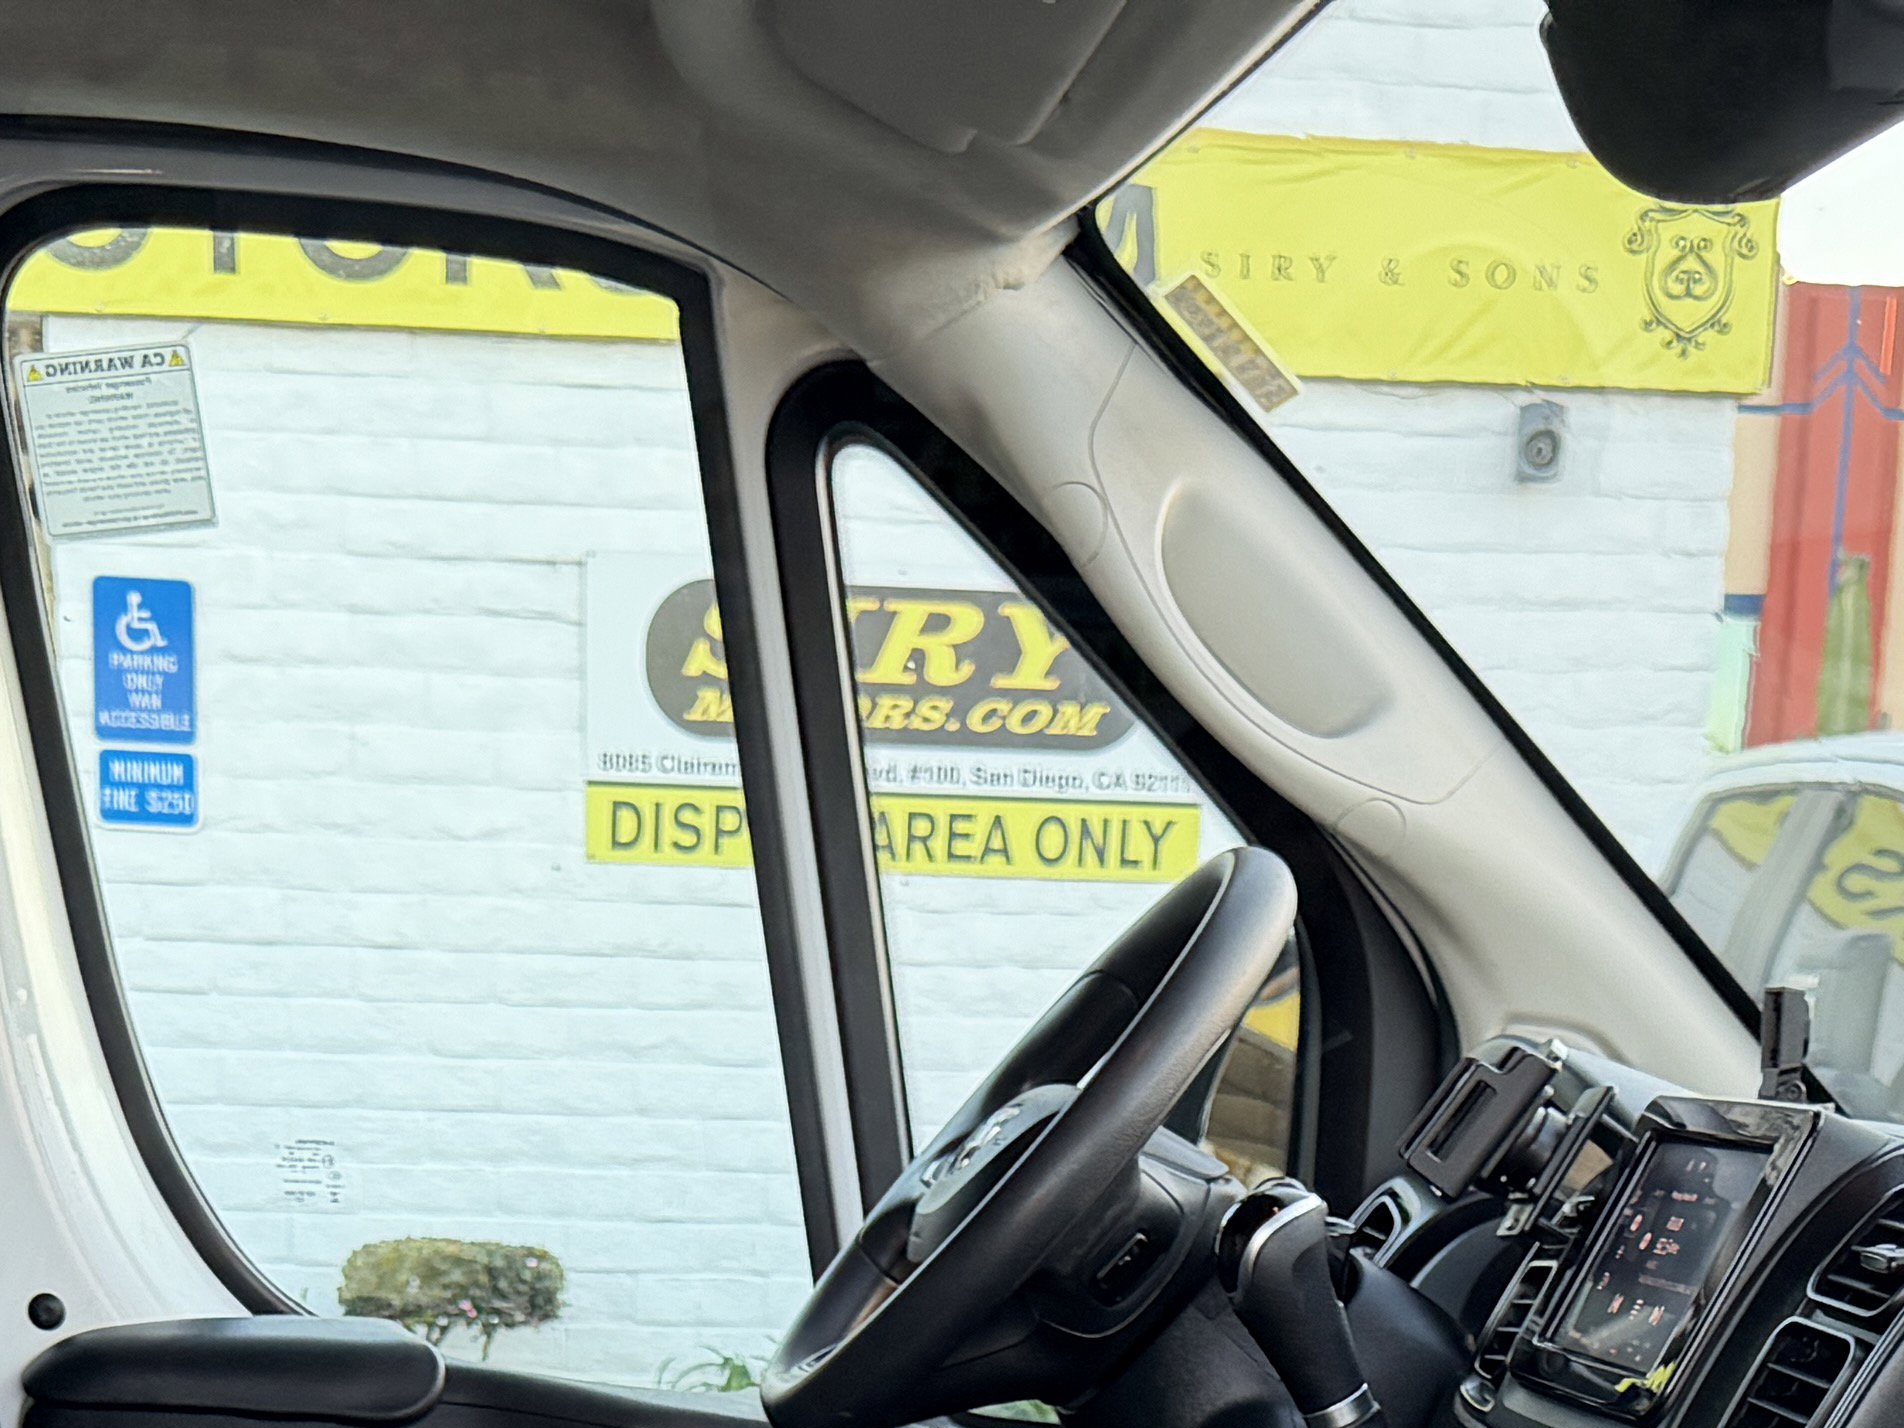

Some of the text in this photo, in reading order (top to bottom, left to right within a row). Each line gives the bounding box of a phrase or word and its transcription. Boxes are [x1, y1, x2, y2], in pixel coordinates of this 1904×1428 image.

[1200, 249, 1600, 294] SIRY & SONS
[109, 652, 179, 674] PARKING
[110, 759, 185, 786] MINIMUM
[611, 799, 1177, 871] DISP AREA ONLY
